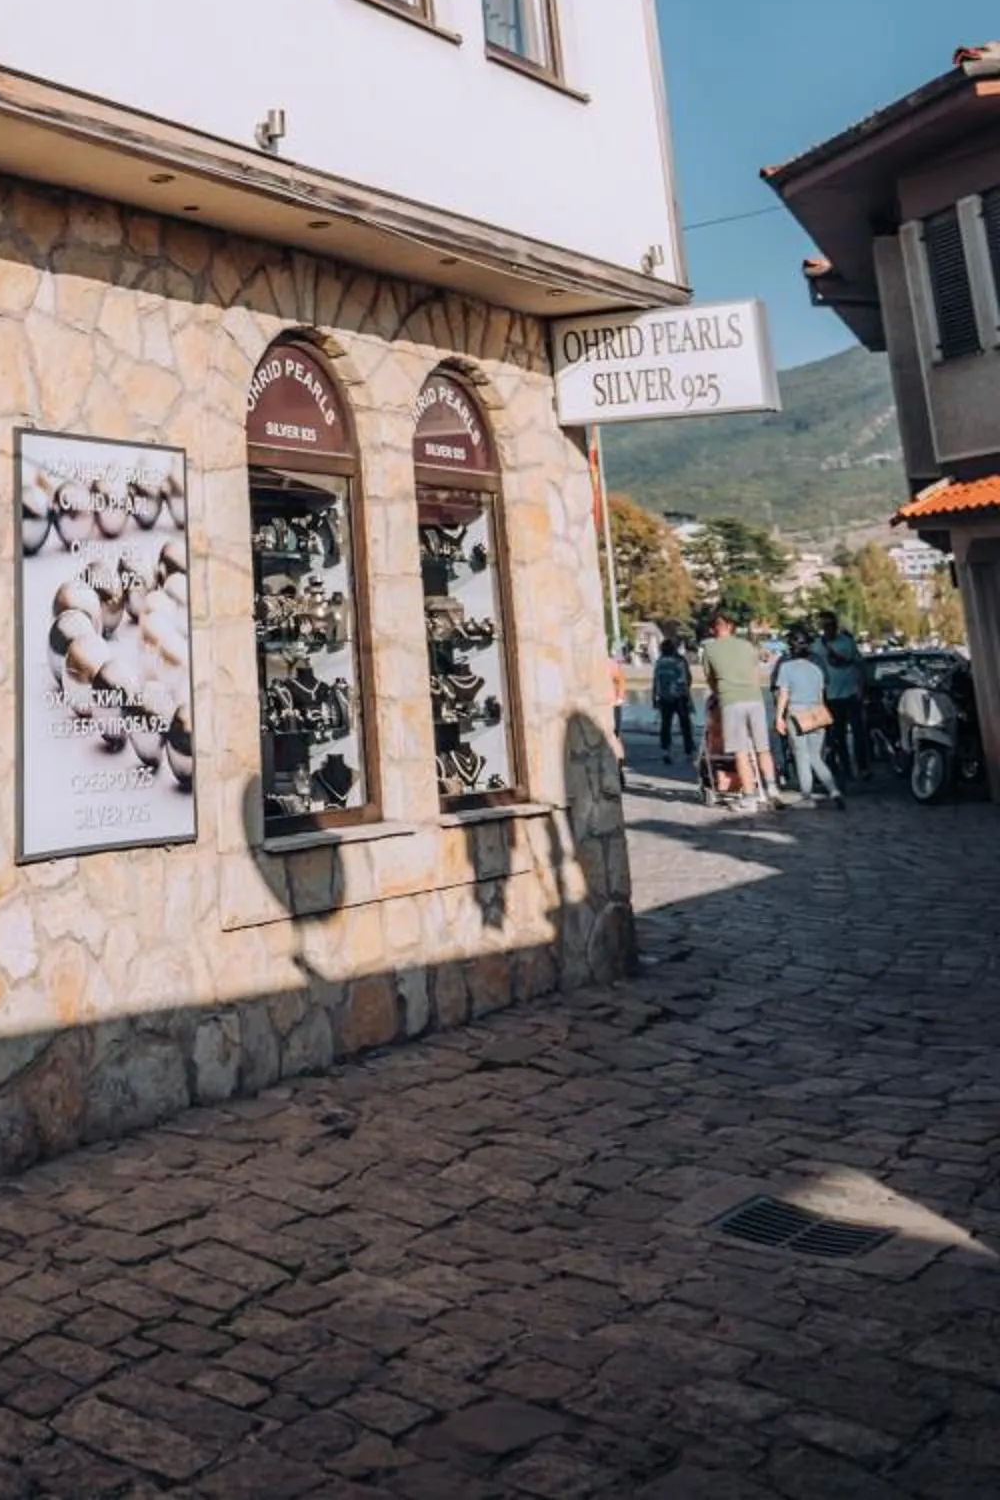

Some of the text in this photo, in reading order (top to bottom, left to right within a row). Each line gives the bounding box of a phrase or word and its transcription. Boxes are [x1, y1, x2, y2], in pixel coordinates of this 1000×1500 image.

[563, 314, 743, 363] OHRID PEARLS
[285, 358, 335, 426] PEARLS
[411, 387, 437, 423] HRID
[593, 367, 721, 407] SILVER 925
